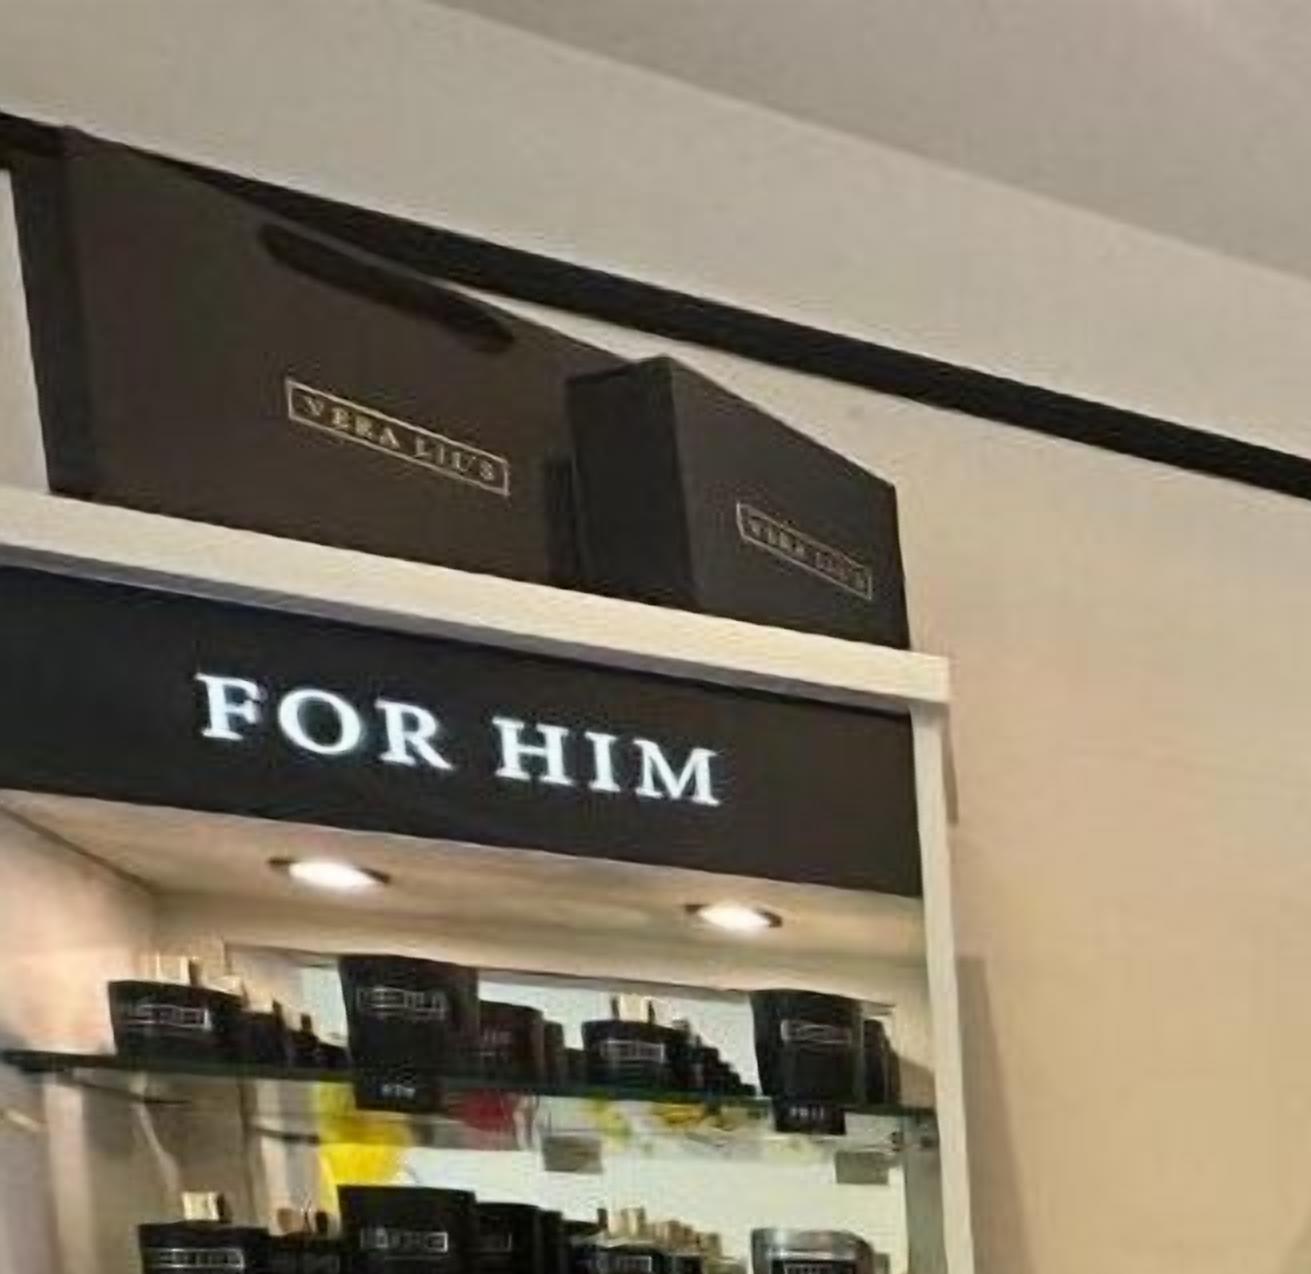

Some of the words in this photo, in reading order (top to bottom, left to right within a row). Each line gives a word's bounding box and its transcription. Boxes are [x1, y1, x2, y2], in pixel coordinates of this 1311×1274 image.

[301, 395, 400, 450] VERA
[196, 673, 454, 771] FOR
[492, 716, 720, 807] HIM
